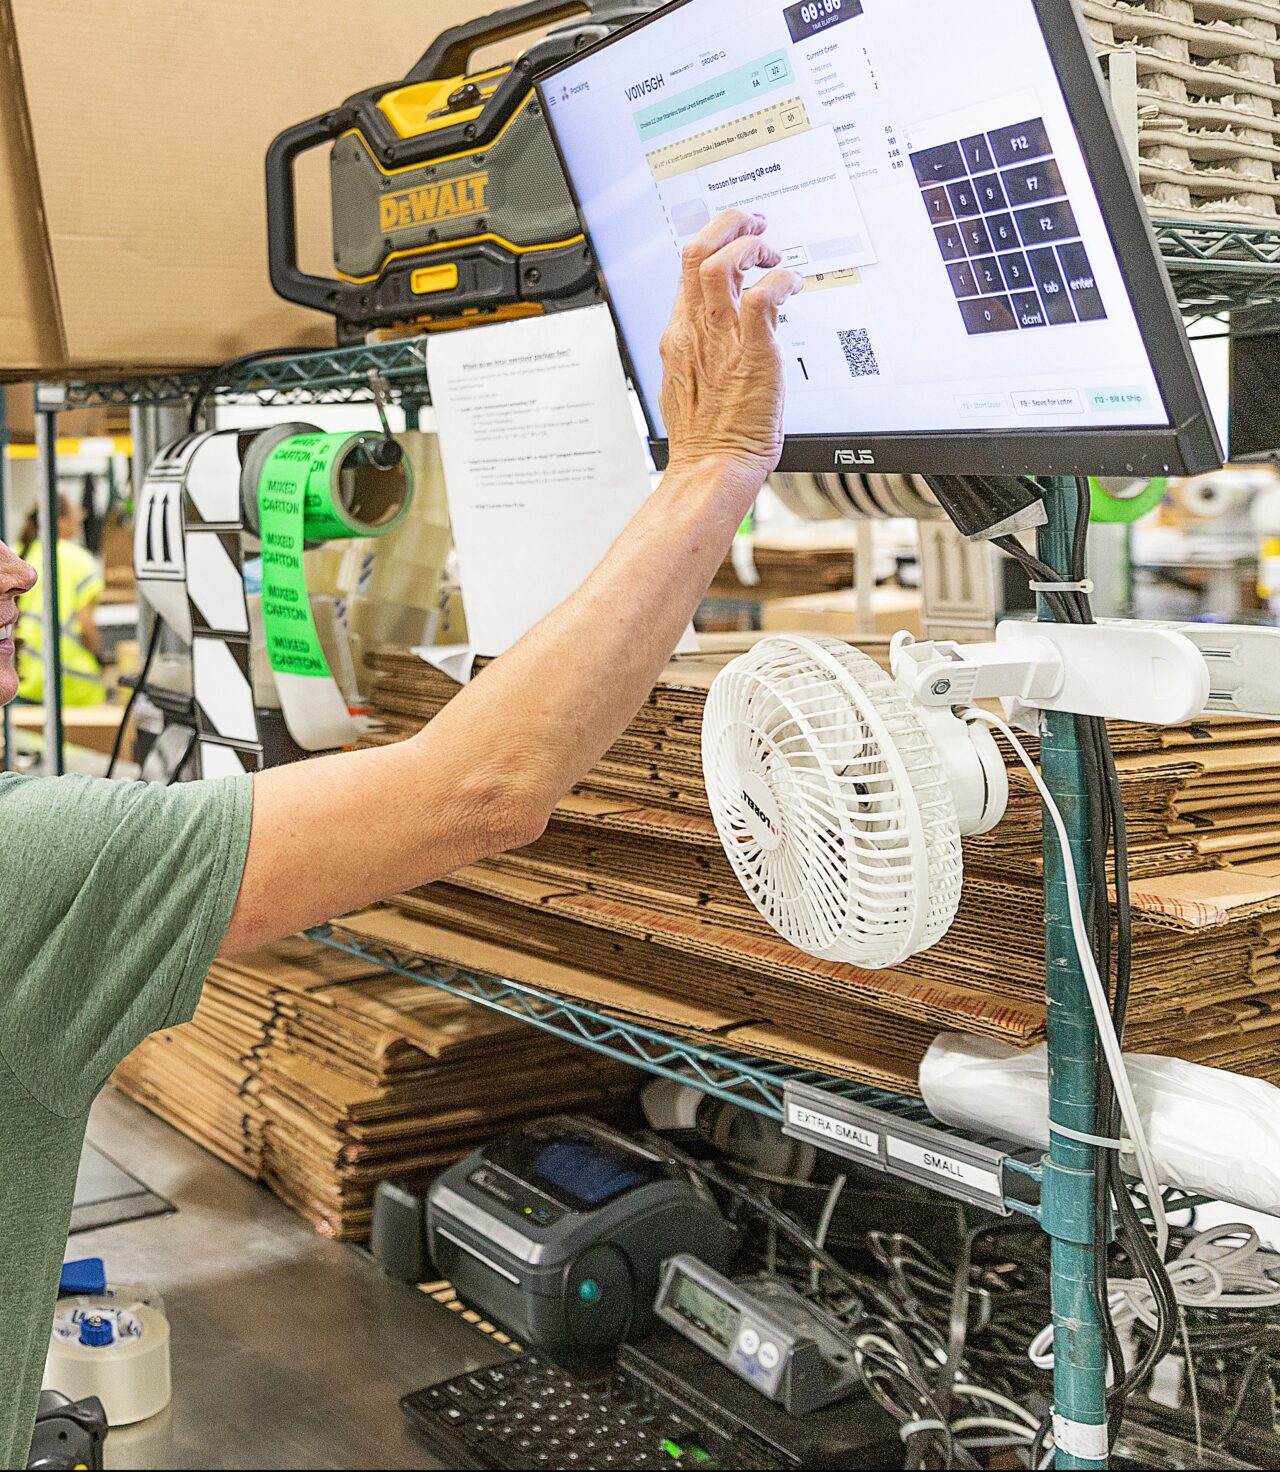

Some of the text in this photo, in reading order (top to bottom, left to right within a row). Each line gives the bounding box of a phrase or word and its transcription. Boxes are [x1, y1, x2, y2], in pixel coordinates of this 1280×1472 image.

[806, 49, 824, 61] Current
[861, 47, 867, 55] 3
[570, 80, 590, 98] Packing
[625, 74, 665, 102] V01V5GH
[752, 78, 761, 88] EA
[767, 125, 776, 134] BD
[884, 126, 893, 134] 60
[888, 137, 897, 146] 161
[1010, 135, 1030, 152] F12
[708, 162, 782, 192] Reason for using QR code
[380, 173, 489, 231] DEWALT
[933, 177, 1040, 212] 7 8 9 F7
[946, 217, 1054, 249] 4 5 6 F2
[959, 266, 1095, 294] 1 2 3 tab enter
[984, 311, 992, 321] 0
[1020, 312, 1043, 326] dcml
[796, 357, 809, 380] 1
[1056, 397, 1074, 405] Later
[1126, 393, 1143, 403] Ship
[275, 449, 313, 462] CARTON
[834, 449, 875, 465] ASUS
[267, 480, 298, 495] MIXED
[262, 498, 300, 515] CARTON
[266, 532, 295, 550] MIXED
[262, 551, 300, 569] CARTON
[267, 585, 299, 603] MIXED
[264, 602, 308, 622] CARTON
[273, 636, 311, 654] MIXED
[271, 653, 324, 671] CARTON
[742, 789, 771, 829] LORELL
[796, 1109, 873, 1148] EXTRA SMALL
[923, 1152, 966, 1179] SMALL
